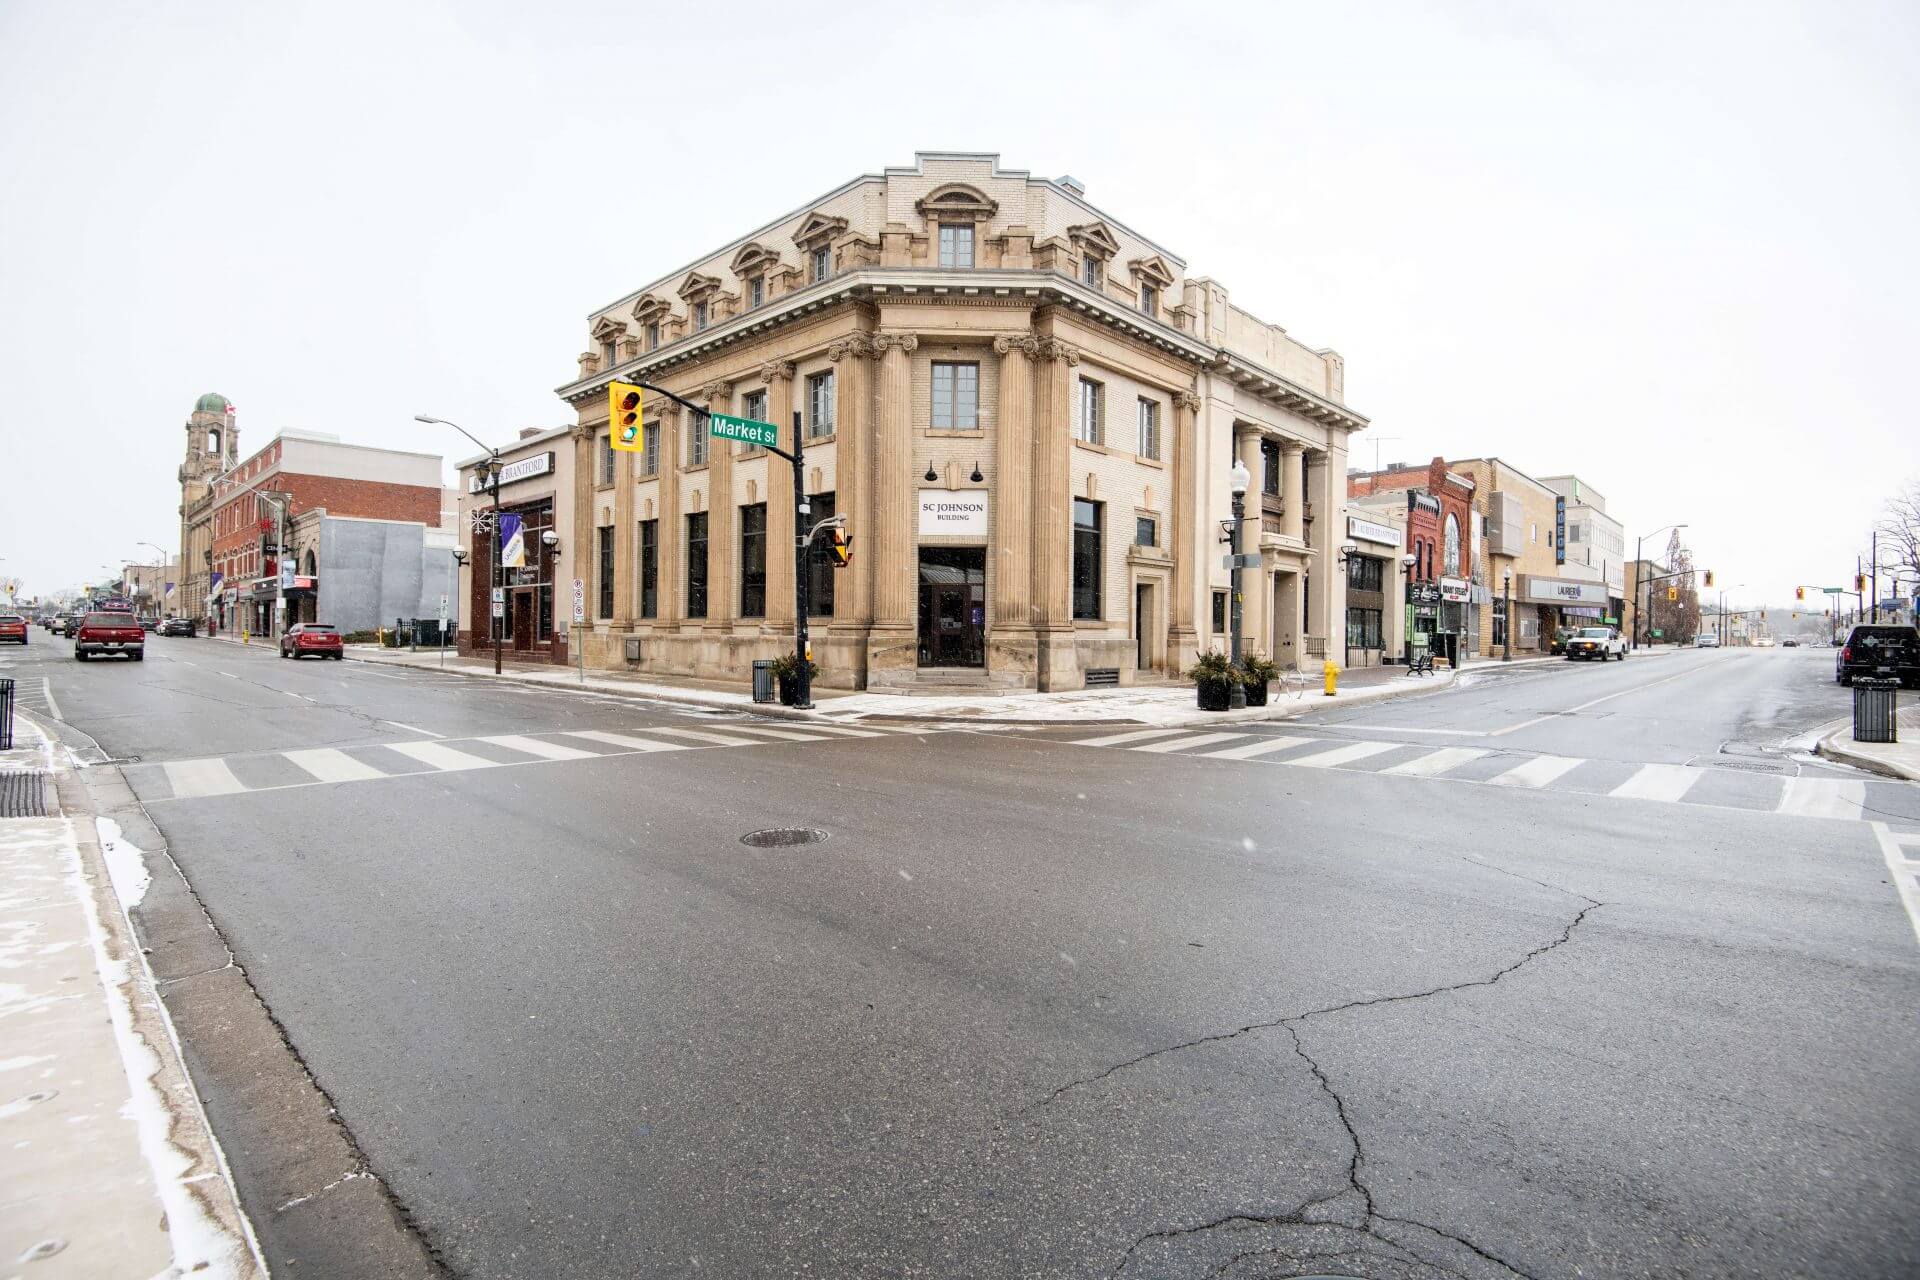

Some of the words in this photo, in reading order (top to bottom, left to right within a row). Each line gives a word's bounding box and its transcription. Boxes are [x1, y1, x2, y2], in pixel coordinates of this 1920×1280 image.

[714, 417, 762, 441] Market
[764, 430, 775, 443] St
[505, 458, 544, 480] BRANTFORD
[922, 503, 936, 511] SC
[937, 503, 984, 513] JOHNSON
[1557, 501, 1565, 560] ODEON
[1557, 585, 1576, 596] LAURIER
